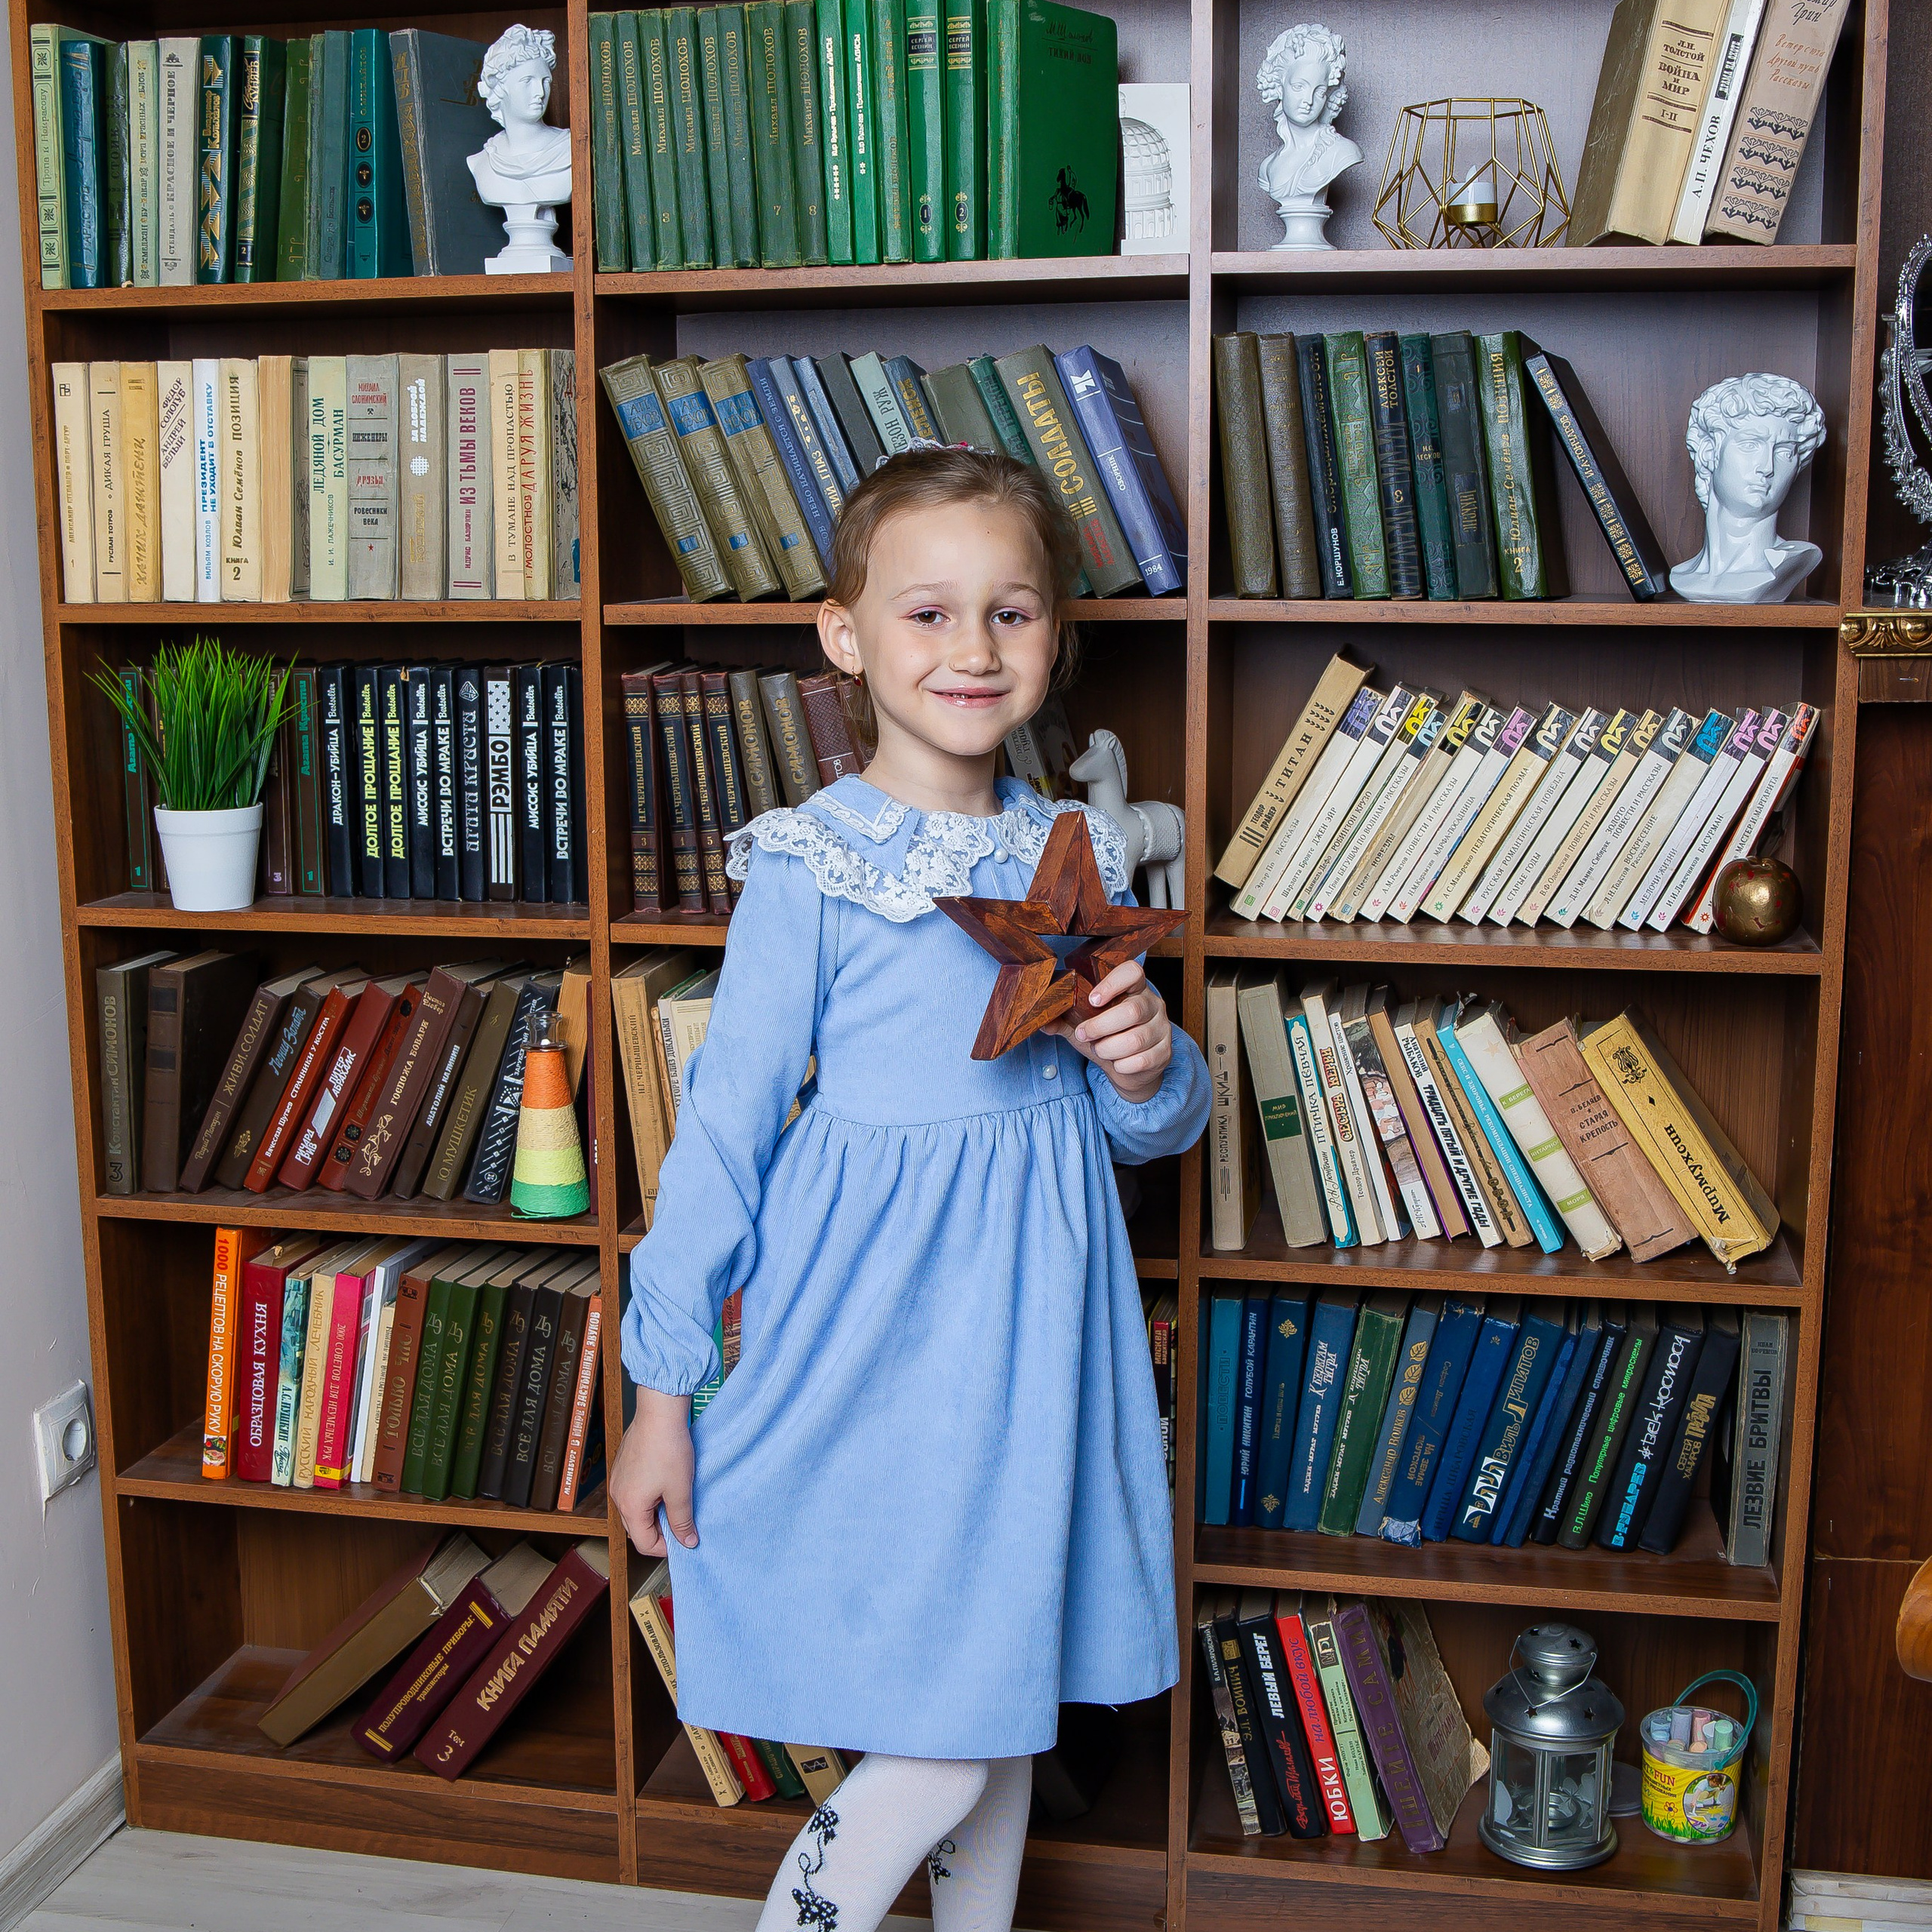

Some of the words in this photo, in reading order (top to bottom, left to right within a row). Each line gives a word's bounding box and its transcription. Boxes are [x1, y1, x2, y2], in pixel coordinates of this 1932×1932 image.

[622, 39, 638, 106] ШОЛОХОВ
[649, 37, 663, 103] ШОЛОХОВ
[677, 36, 692, 103] ШОЛОХОВ
[763, 26, 776, 93] ШОЛОХОВ
[796, 26, 811, 94] ШОЛОХОВ
[1657, 60, 1703, 82] ВОЙНА
[1662, 42, 1706, 63] ТОЛСТОЙ
[1661, 80, 1690, 97] МИР
[1768, 67, 1812, 91] Рассказы
[38, 88, 50, 141] Некрасову
[628, 108, 642, 155] Михаил
[654, 107, 668, 152] Михаил
[682, 106, 696, 152] Михаил
[767, 97, 780, 143] Михаил
[801, 97, 814, 144] Михаил
[40, 156, 51, 186] Тропа
[757, 374, 780, 414] ЗЕМЛИ
[1374, 350, 1389, 409] АЛЕКСЕЙ
[1383, 348, 1399, 408] ТОЛСТОЙ
[159, 387, 187, 429] СОЛОГУБ
[311, 397, 325, 427] ДОМ
[408, 385, 419, 426] ДОБРОЙ
[415, 377, 427, 442] НАДЕЖДОЙ
[503, 383, 515, 460] ПРОПАСТЬЮ
[773, 413, 783, 422] С
[101, 408, 111, 446] ГРУША
[161, 417, 187, 455] АНДРЕЙ
[330, 408, 346, 478] БАСУРМАН
[352, 432, 387, 442] ИНЖЕНЕРЫ
[411, 426, 420, 442] ЗА
[1018, 369, 1081, 498] СОЛДАТЫ
[103, 451, 113, 490] ДИКАЯ
[162, 436, 186, 469] БЕЛЫЙ
[310, 432, 327, 493] ЛЕДЯНОЙ
[777, 422, 809, 487] НАЧИНАЕТСЯ
[1104, 454, 1128, 491] ОЗОРНИК
[199, 438, 208, 512] ПРЕЗИДЕНТ
[506, 464, 516, 491] НАД
[506, 497, 517, 546] ТУМАНЕ
[803, 486, 821, 517] НЕБО
[232, 566, 240, 580] 2
[1143, 561, 1164, 577] 1984
[1331, 526, 1345, 585] Е.КОРШУНОВ
[297, 679, 309, 731] Кристи
[326, 681, 337, 717] Bestseller
[361, 682, 371, 717] Bestseller
[387, 682, 398, 718] Bestseller
[415, 682, 425, 718] Bestseller
[436, 682, 447, 718] Bestseller
[525, 684, 534, 721] Bestseller
[554, 685, 564, 720] Bestseller
[300, 734, 310, 775] Агата
[361, 725, 377, 798] ПРОЩАНИЕ
[414, 729, 427, 775] УБИЙЦА
[437, 726, 450, 773] МРАКЕ
[525, 731, 537, 778] УБИЙЦА
[553, 729, 567, 776] МРАКЕ
[737, 698, 765, 787] СИМОНОВ
[774, 695, 808, 786] СИМОНОВ
[1274, 731, 1312, 790] ТИТАН
[328, 728, 343, 825] ДРАКОН-УБИЙЦА
[388, 725, 402, 799] ПРОЩАНИЕ
[488, 738, 512, 809] РЭМБО
[1634, 761, 1665, 800] РАССКАЗЫ
[417, 779, 428, 826] МИССИС
[438, 775, 451, 795] ВО
[527, 782, 539, 829] МИССИС
[555, 779, 568, 799] ВО
[1631, 796, 1642, 808] И
[1751, 773, 1780, 817] МАРГАРИТА
[365, 803, 380, 857] ДОЛГОЕ
[390, 803, 405, 857] ДОЛГОЕ
[440, 798, 454, 856] ВСТРЕЧИ
[555, 801, 569, 860] ВСТРЕЧИ
[1248, 802, 1266, 826] ТЕОДОР
[1258, 804, 1278, 831] ДРАЙЗЕР
[1479, 865, 1505, 900] РУССКАЯ
[1500, 803, 1545, 867] РОМАНТИЧЕСКАЯ
[1540, 768, 1567, 805] НОВЕЛЛА
[1603, 804, 1628, 835] ЗОЛОТО
[1610, 803, 1638, 840] ПОВЕСТИ
[1748, 814, 1759, 825] И
[1280, 866, 1303, 898] Шарлотта
[1297, 845, 1315, 869] Бронте
[1310, 821, 1329, 846] ДЖЕН
[1323, 805, 1338, 823] ЭЙР
[1623, 811, 1660, 866] ВОСКРЕСЕНИЕ
[1629, 838, 1651, 869] Рассказы
[1734, 822, 1755, 854] МАСТЕР
[1504, 871, 1529, 902] СТАРЫЕ
[1523, 851, 1543, 874] ГОДЫ
[1638, 872, 1663, 906] МЕЛОЧИ
[1656, 846, 1679, 876] ЖИЗНИ
[1332, 1021, 1344, 1043] цветов
[1408, 1034, 1429, 1072] Анатолий
[388, 1057, 417, 1106] ГОСПОЖА
[407, 1018, 432, 1057] БОВАРИ
[1318, 1045, 1341, 1088] КЕРРИ
[1337, 1043, 1352, 1075] Хранение
[1401, 1037, 1423, 1079] РЫБАКОВ
[423, 1081, 446, 1127] АНАТОЛИЙ
[441, 1043, 461, 1083] КАЛИНИН
[1216, 1070, 1232, 1106] ШКИД
[1217, 1113, 1229, 1161] РЕСПУБЛИКА
[1329, 1091, 1354, 1143] СЕСТРА
[1577, 1109, 1611, 1131] СТАРАЯ
[1578, 1119, 1620, 1144] КРЕПОСТЬ
[294, 1127, 315, 1161] РИЧАРД
[1345, 1149, 1360, 1176] Драйзер
[1351, 1175, 1364, 1198] Теодор
[1661, 1121, 1734, 1225] Мирмухсин
[1565, 1192, 1586, 1208] МОРЯ
[216, 1238, 229, 1272] 1000
[212, 1273, 228, 1335] РЕЦЕПТОВ
[308, 1287, 325, 1352] ЛЕЧЕБНИК
[212, 1336, 224, 1353] НА
[253, 1300, 267, 1355] КУХНЯ
[336, 1323, 346, 1341] 2000
[1152, 1329, 1164, 1364] МОСКВА
[209, 1354, 224, 1403] СКОРУЮ
[331, 1341, 344, 1381] СОВЕТОВ
[1322, 1350, 1339, 1384] ТИГРА
[249, 1361, 266, 1447] ОБРАЗЦОВАЯ
[303, 1356, 319, 1420] НАРОДНЫЙ
[328, 1383, 340, 1399] ДЛЯ
[1746, 1368, 1774, 1450] БРИТВЫ
[208, 1403, 221, 1434] РУКУ
[322, 1401, 338, 1444] НЕУМЕЛЫХ
[297, 1426, 315, 1479] РУССКИЙ
[321, 1445, 333, 1461] РУК
[1675, 1437, 1694, 1471] СЕРГЕЙ
[1740, 1458, 1767, 1529] ЛЕЗВИЕ
[473, 1649, 526, 1712] КНИГА
[515, 1575, 580, 1655] ПАМЯТИ
[641, 1618, 674, 1677] ИСПОЛЬЗОВАНИЕ
[1252, 1629, 1273, 1671] БЕРЕГ
[1287, 1634, 1309, 1671] вкус
[415, 1662, 451, 1703] транзисторы
[1260, 1671, 1284, 1720] ЛЕВЫЙ
[1294, 1671, 1321, 1723] любой
[446, 1728, 467, 1746] Том
[1309, 1721, 1326, 1744] на
[1317, 1754, 1349, 1823] ЮБКИ
[1654, 1770, 1675, 1787] FUN
